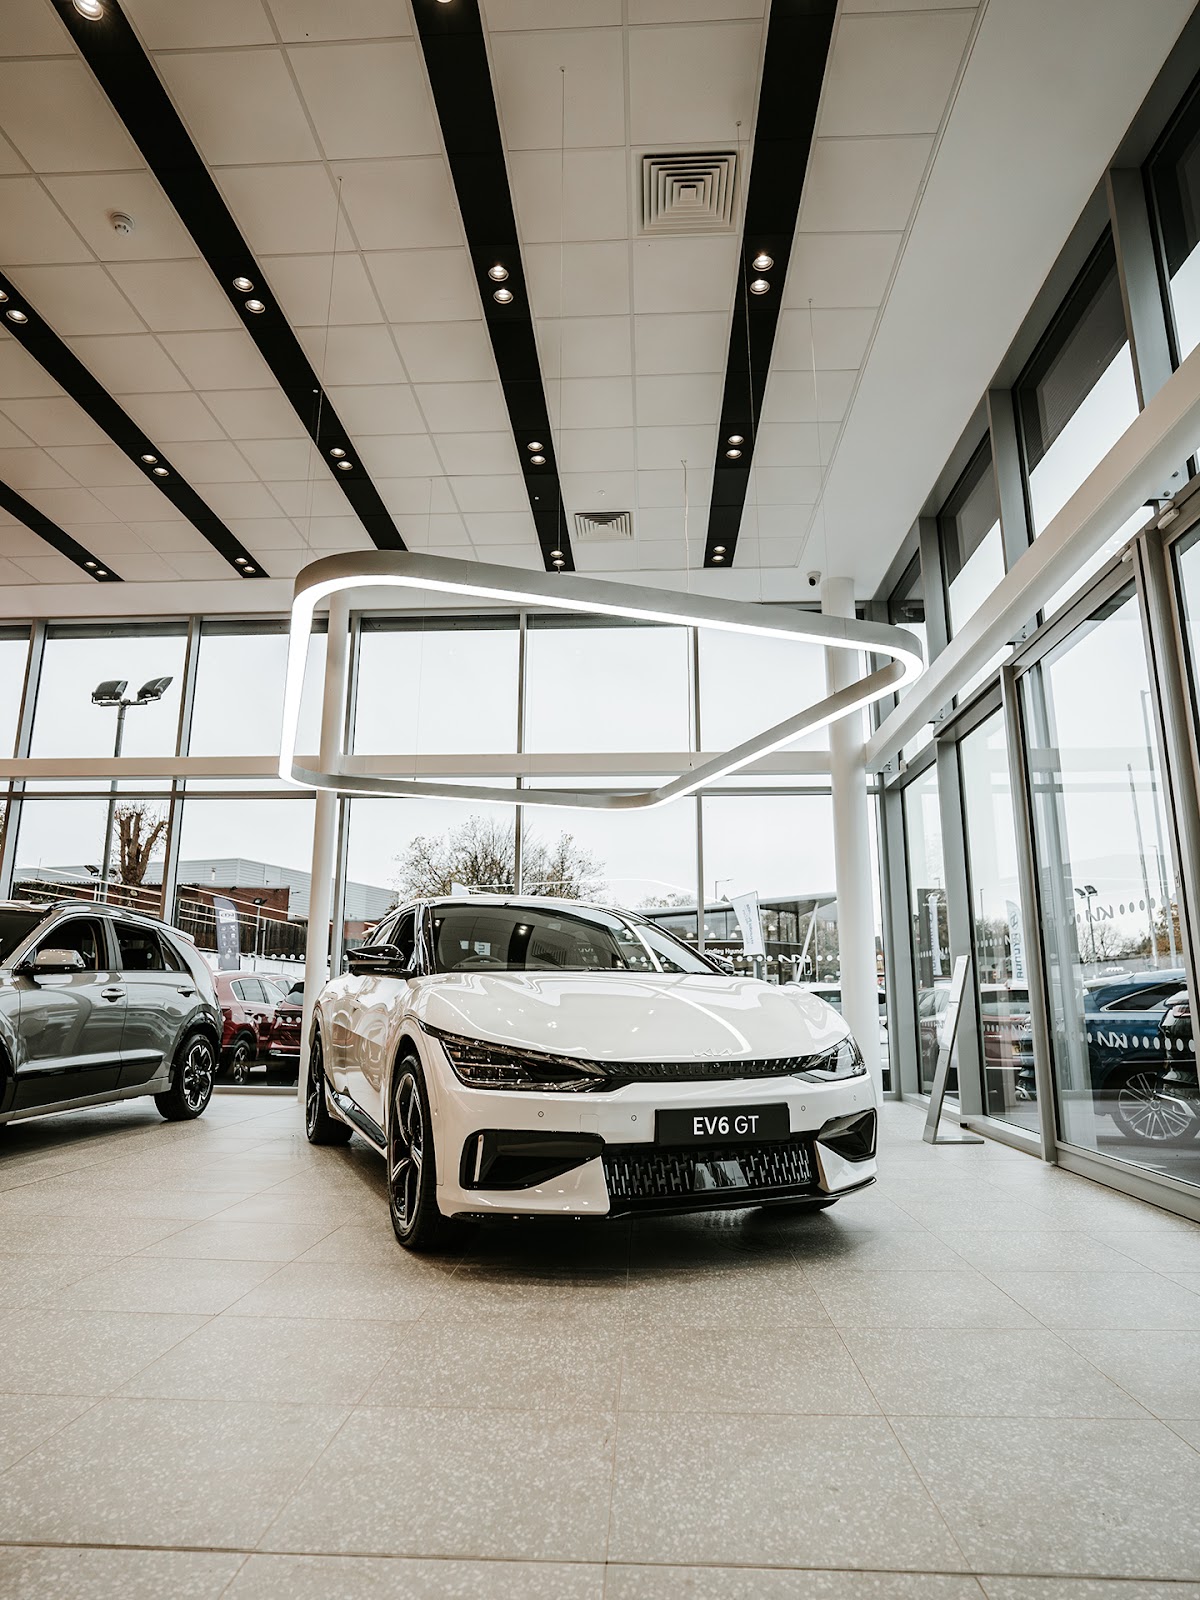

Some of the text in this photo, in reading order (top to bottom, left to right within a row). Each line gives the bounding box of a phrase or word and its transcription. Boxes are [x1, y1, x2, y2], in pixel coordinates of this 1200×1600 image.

[691, 1048, 734, 1057] KIA
[693, 1115, 759, 1136] EV6 GT
